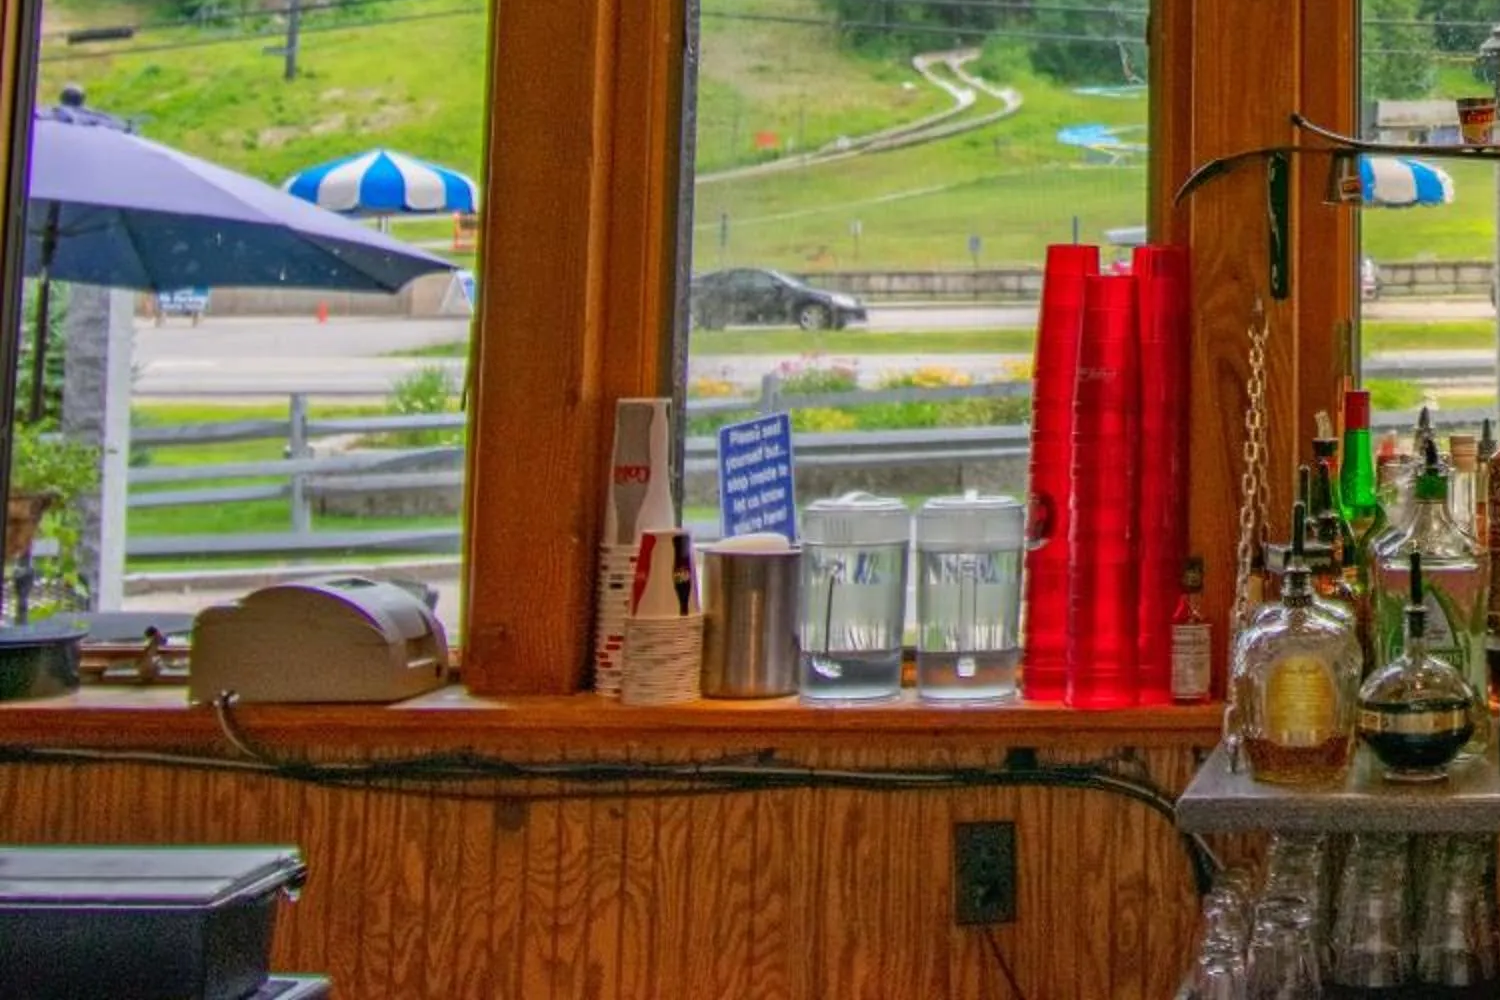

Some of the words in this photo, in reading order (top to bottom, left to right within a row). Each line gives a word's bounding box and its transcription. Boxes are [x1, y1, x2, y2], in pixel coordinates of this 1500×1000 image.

[726, 447, 763, 476] yourself
[749, 466, 777, 487] inside
[760, 487, 785, 503] know
